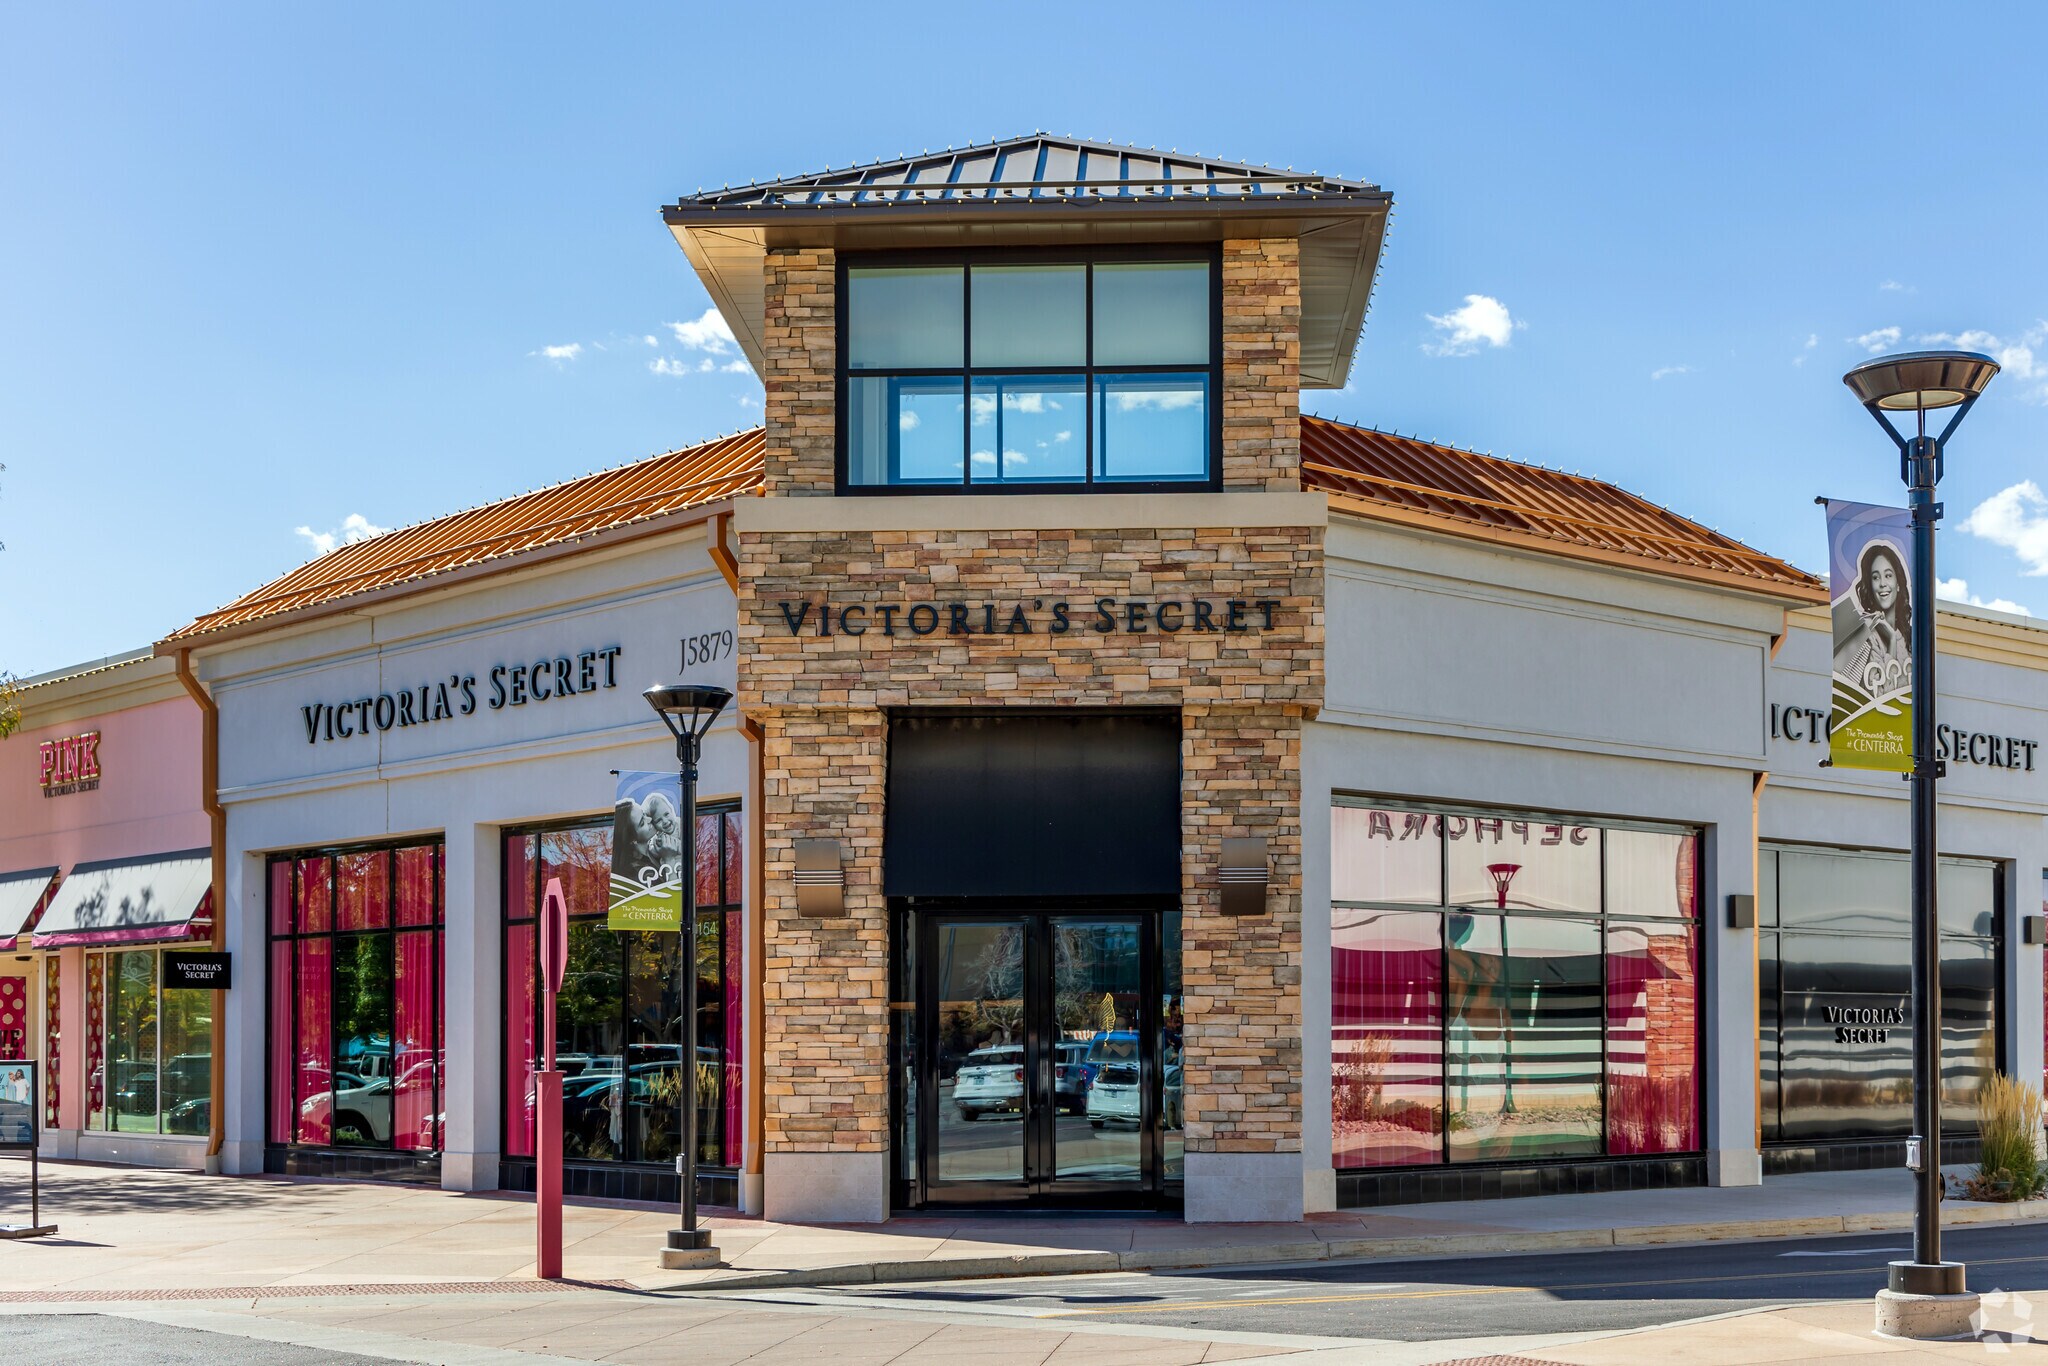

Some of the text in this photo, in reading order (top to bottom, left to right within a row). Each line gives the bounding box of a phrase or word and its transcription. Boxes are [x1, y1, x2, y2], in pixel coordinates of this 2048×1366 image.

[778, 598, 1281, 637] VICTORIA'S SECRET
[679, 629, 733, 676] J5879
[300, 647, 621, 743] VICTORIA'S SECRET
[1845, 727, 1856, 737] The
[1887, 731, 1904, 742] Shops
[1853, 738, 1904, 754] CENTERRA
[1937, 723, 2038, 772] SECRET
[40, 730, 101, 787] PINK
[43, 779, 100, 799] VICTORIA'S SECRET
[628, 911, 674, 921] CENTERRA
[177, 962, 222, 971] VICTORIA'S
[185, 970, 215, 979] SECRET
[1828, 1006, 1904, 1024] VICTORIA'S
[1841, 1027, 1891, 1044] SECRET
